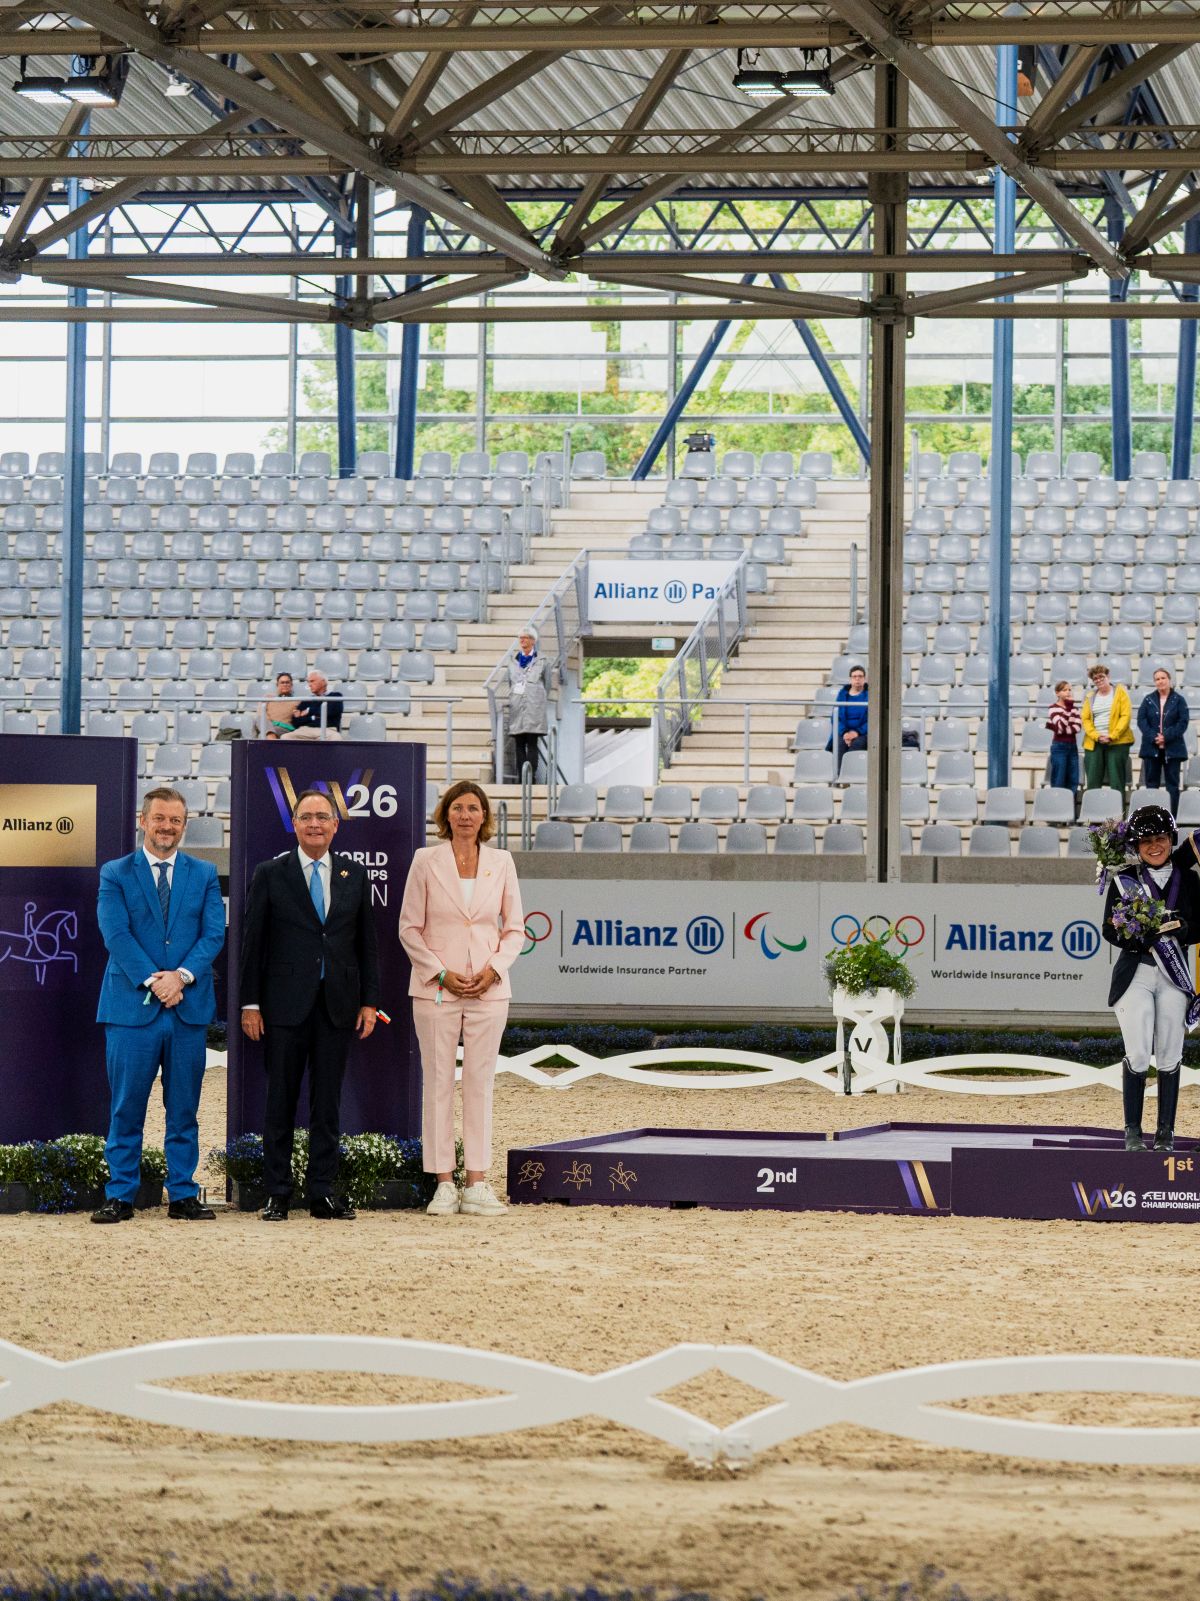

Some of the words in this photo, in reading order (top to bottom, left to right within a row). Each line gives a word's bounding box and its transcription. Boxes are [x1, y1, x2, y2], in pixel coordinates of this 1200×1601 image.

[594, 583, 659, 599] Allianz
[2, 818, 53, 831] Allianz
[572, 919, 678, 947] Allianz
[945, 924, 1053, 951] Allianz
[558, 965, 614, 975] Worldwide
[616, 965, 666, 975] Insurance
[668, 966, 707, 976] Partner
[931, 970, 988, 979] Worldwide
[990, 971, 1041, 980] Insurance
[1043, 972, 1083, 981] Partner
[854, 1038, 873, 1054] V
[1163, 1156, 1194, 1181] 1st
[756, 1167, 797, 1193] 2nd
[1141, 1191, 1166, 1201] FEI
